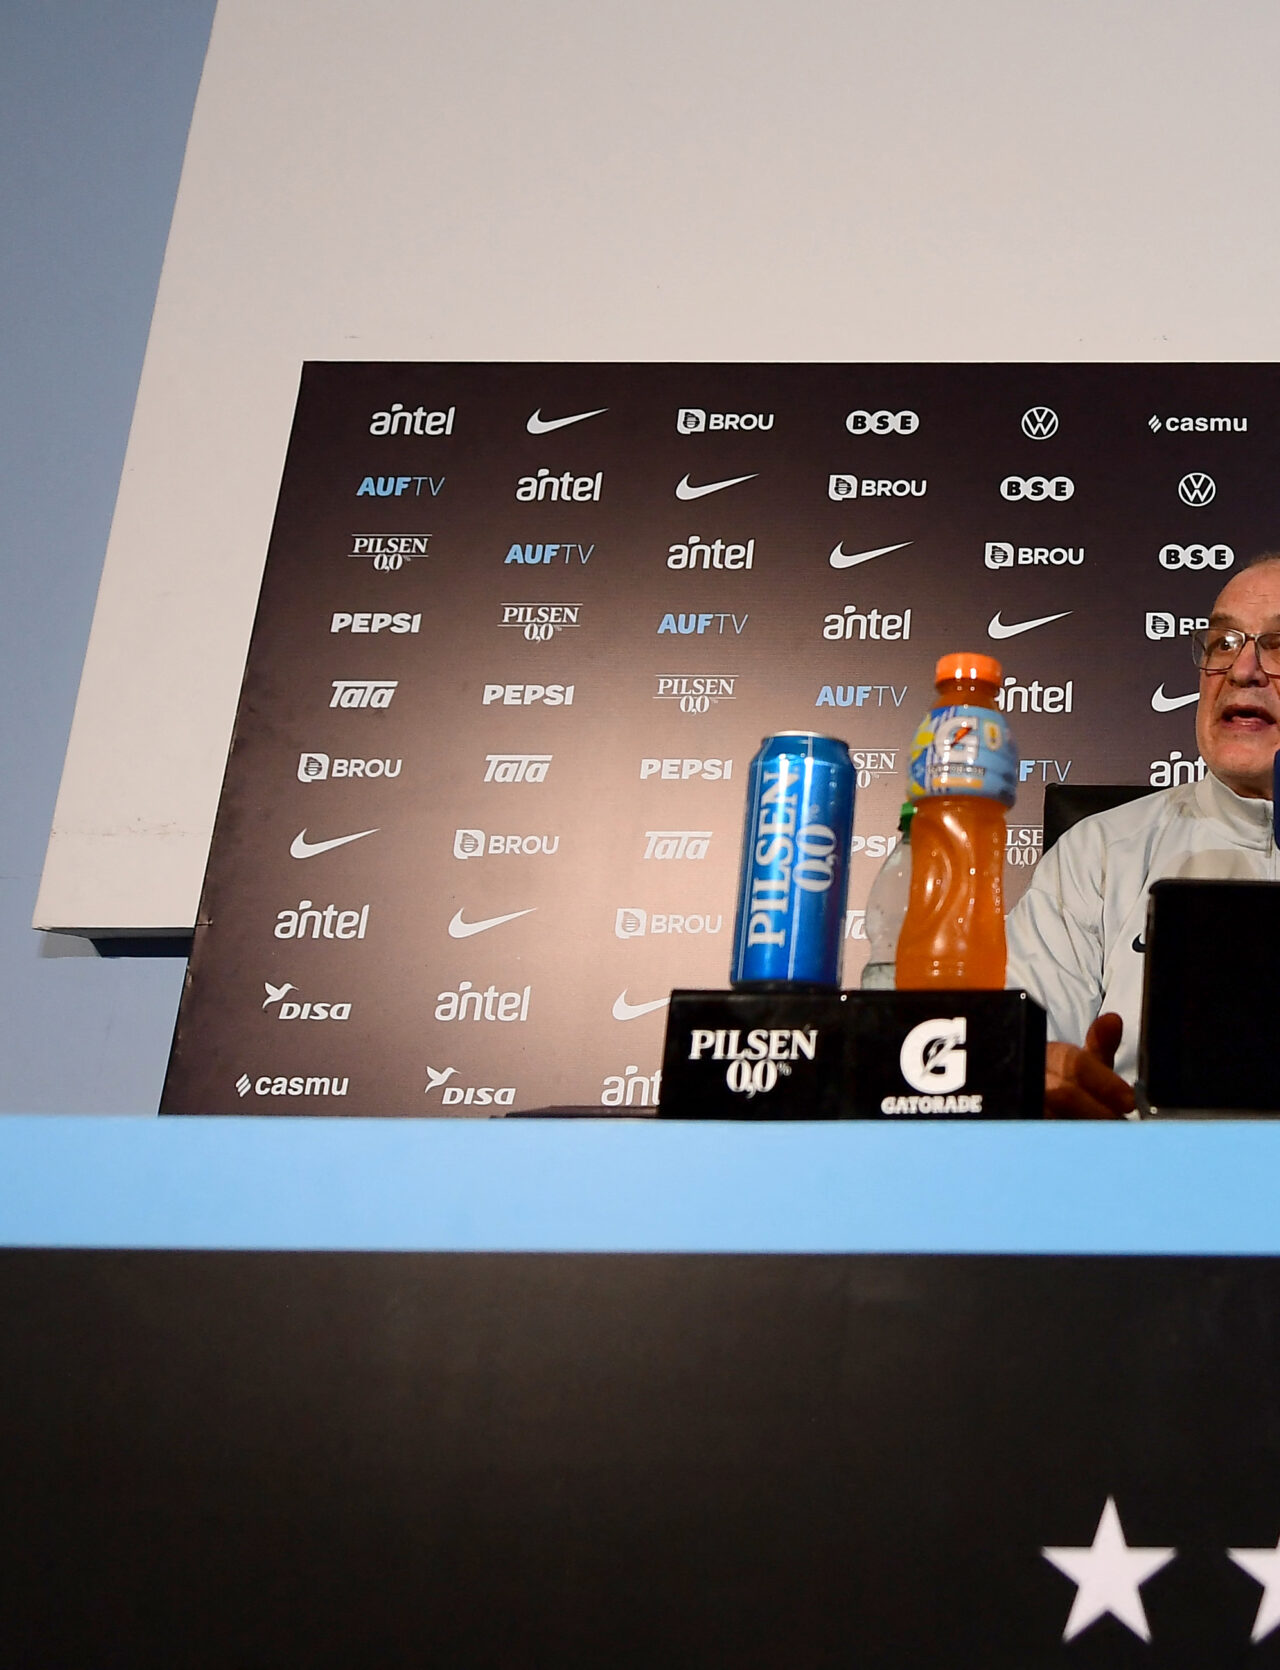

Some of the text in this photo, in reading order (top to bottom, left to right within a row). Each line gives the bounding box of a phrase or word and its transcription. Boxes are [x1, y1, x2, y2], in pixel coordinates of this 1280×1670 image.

[370, 404, 455, 435] antel
[709, 414, 774, 430] BROU
[849, 413, 916, 432] BSE
[1166, 418, 1247, 431] casmu
[516, 469, 602, 501] antel
[861, 480, 926, 496] BROU
[1003, 478, 1071, 499] BSE
[352, 537, 429, 553] PILSEN
[668, 536, 754, 569] antel
[1018, 548, 1084, 564] BROU
[1162, 546, 1231, 568] BSE
[331, 613, 421, 633] PEPSI
[501, 606, 580, 624] PILSEN
[823, 606, 911, 639] antel
[483, 685, 574, 705] PEPSI
[656, 678, 735, 696] PILSEN
[332, 759, 402, 777] BROU
[640, 759, 732, 780] PEPSI
[853, 752, 896, 770] SEN
[1019, 760, 1072, 782] FTV
[1150, 751, 1207, 787] ant
[488, 836, 559, 854] BROU
[851, 835, 897, 858] PSI
[1005, 829, 1043, 847] LSE
[747, 769, 799, 948] PILSEN
[275, 901, 369, 939] antel
[650, 915, 722, 934] BROU
[434, 981, 530, 1022] antel
[688, 1029, 818, 1060] PILSEN
[899, 1017, 966, 1094] G
[255, 1077, 348, 1095] casmu
[601, 1065, 663, 1106] ant
[880, 1095, 983, 1115] GATORADE
